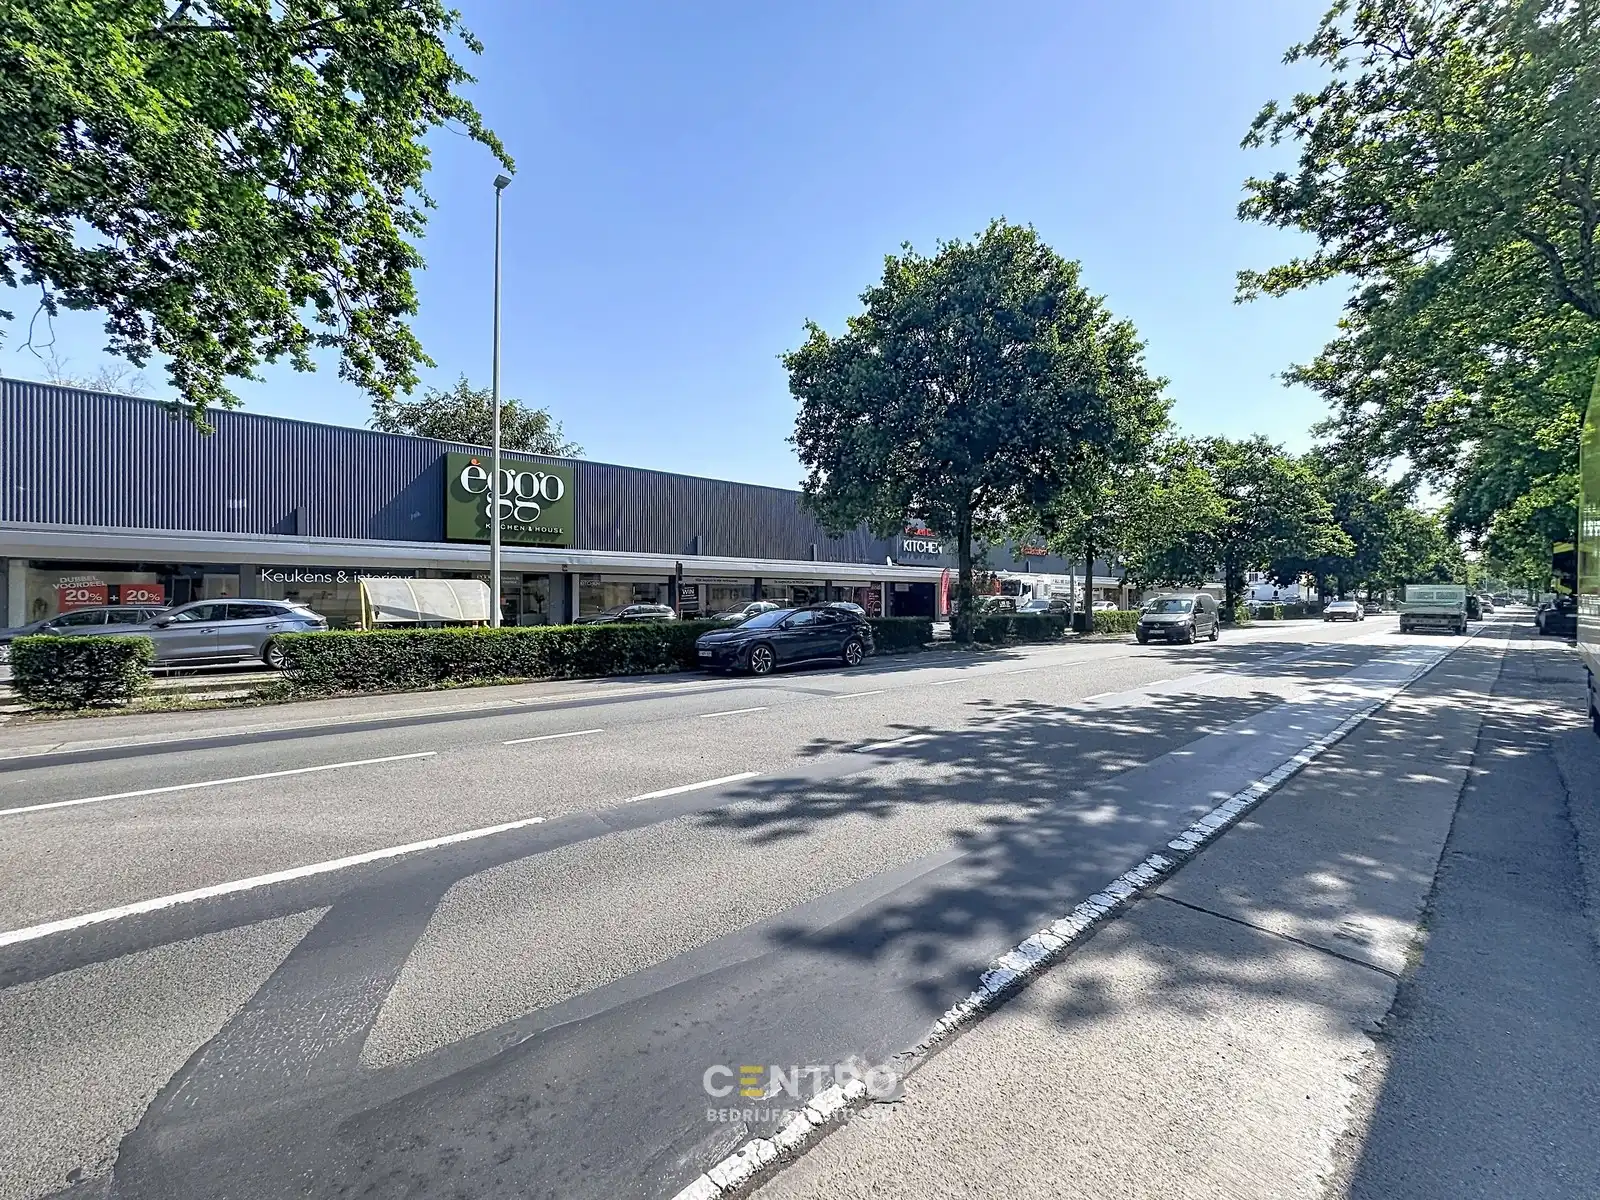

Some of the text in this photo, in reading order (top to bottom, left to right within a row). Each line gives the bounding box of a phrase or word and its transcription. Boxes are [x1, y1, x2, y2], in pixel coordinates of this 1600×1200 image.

[485, 523, 525, 531] KCHEN
[59, 575, 99, 583] DUBBEL
[261, 569, 332, 583] Keukens
[336, 570, 349, 584] &
[52, 581, 107, 590] VOORDEEL
[65, 590, 102, 601] 20%
[126, 590, 161, 601] 20%
